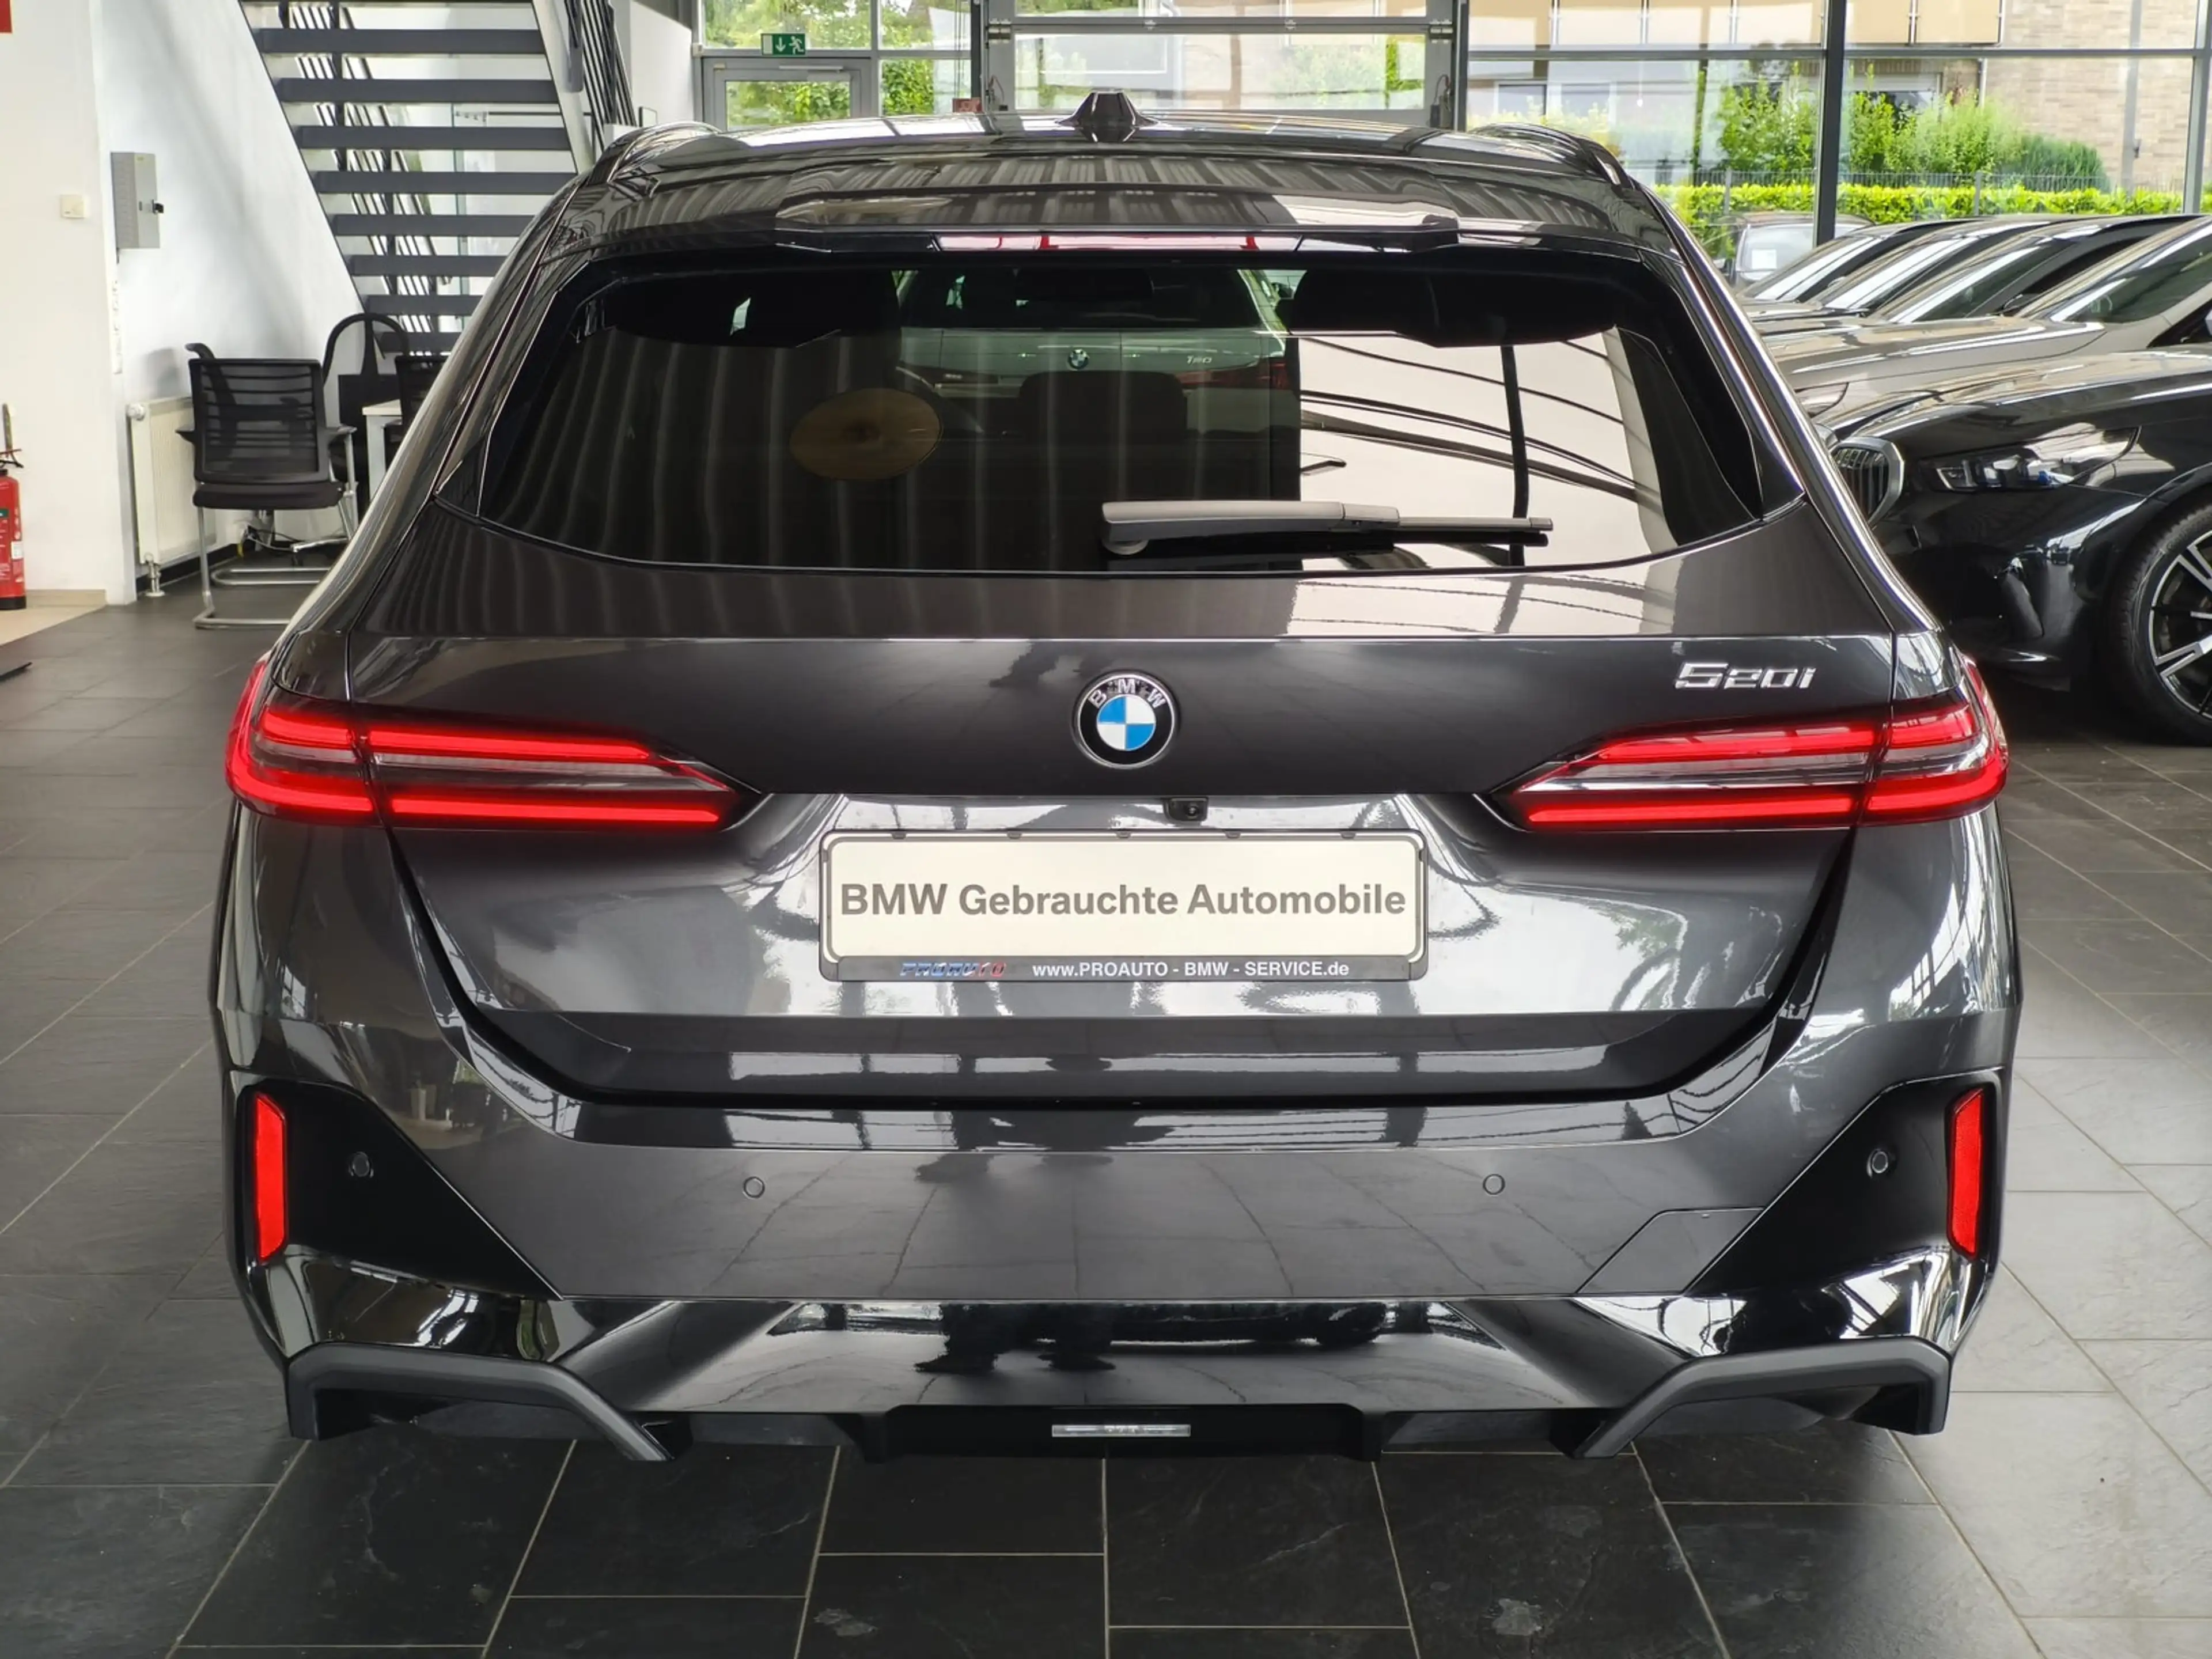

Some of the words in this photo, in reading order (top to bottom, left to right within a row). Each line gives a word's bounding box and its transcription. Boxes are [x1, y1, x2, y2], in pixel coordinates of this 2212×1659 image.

[1675, 662, 1816, 690] 520i
[1088, 679, 1166, 709] BMW
[842, 883, 948, 915] BMW
[959, 884, 1178, 915] Gebrauchte
[1187, 884, 1406, 914] Automobile
[1032, 961, 1168, 976] www.PROAUTO
[1184, 961, 1229, 976] BMW
[1245, 961, 1349, 976] SERVICE.de
